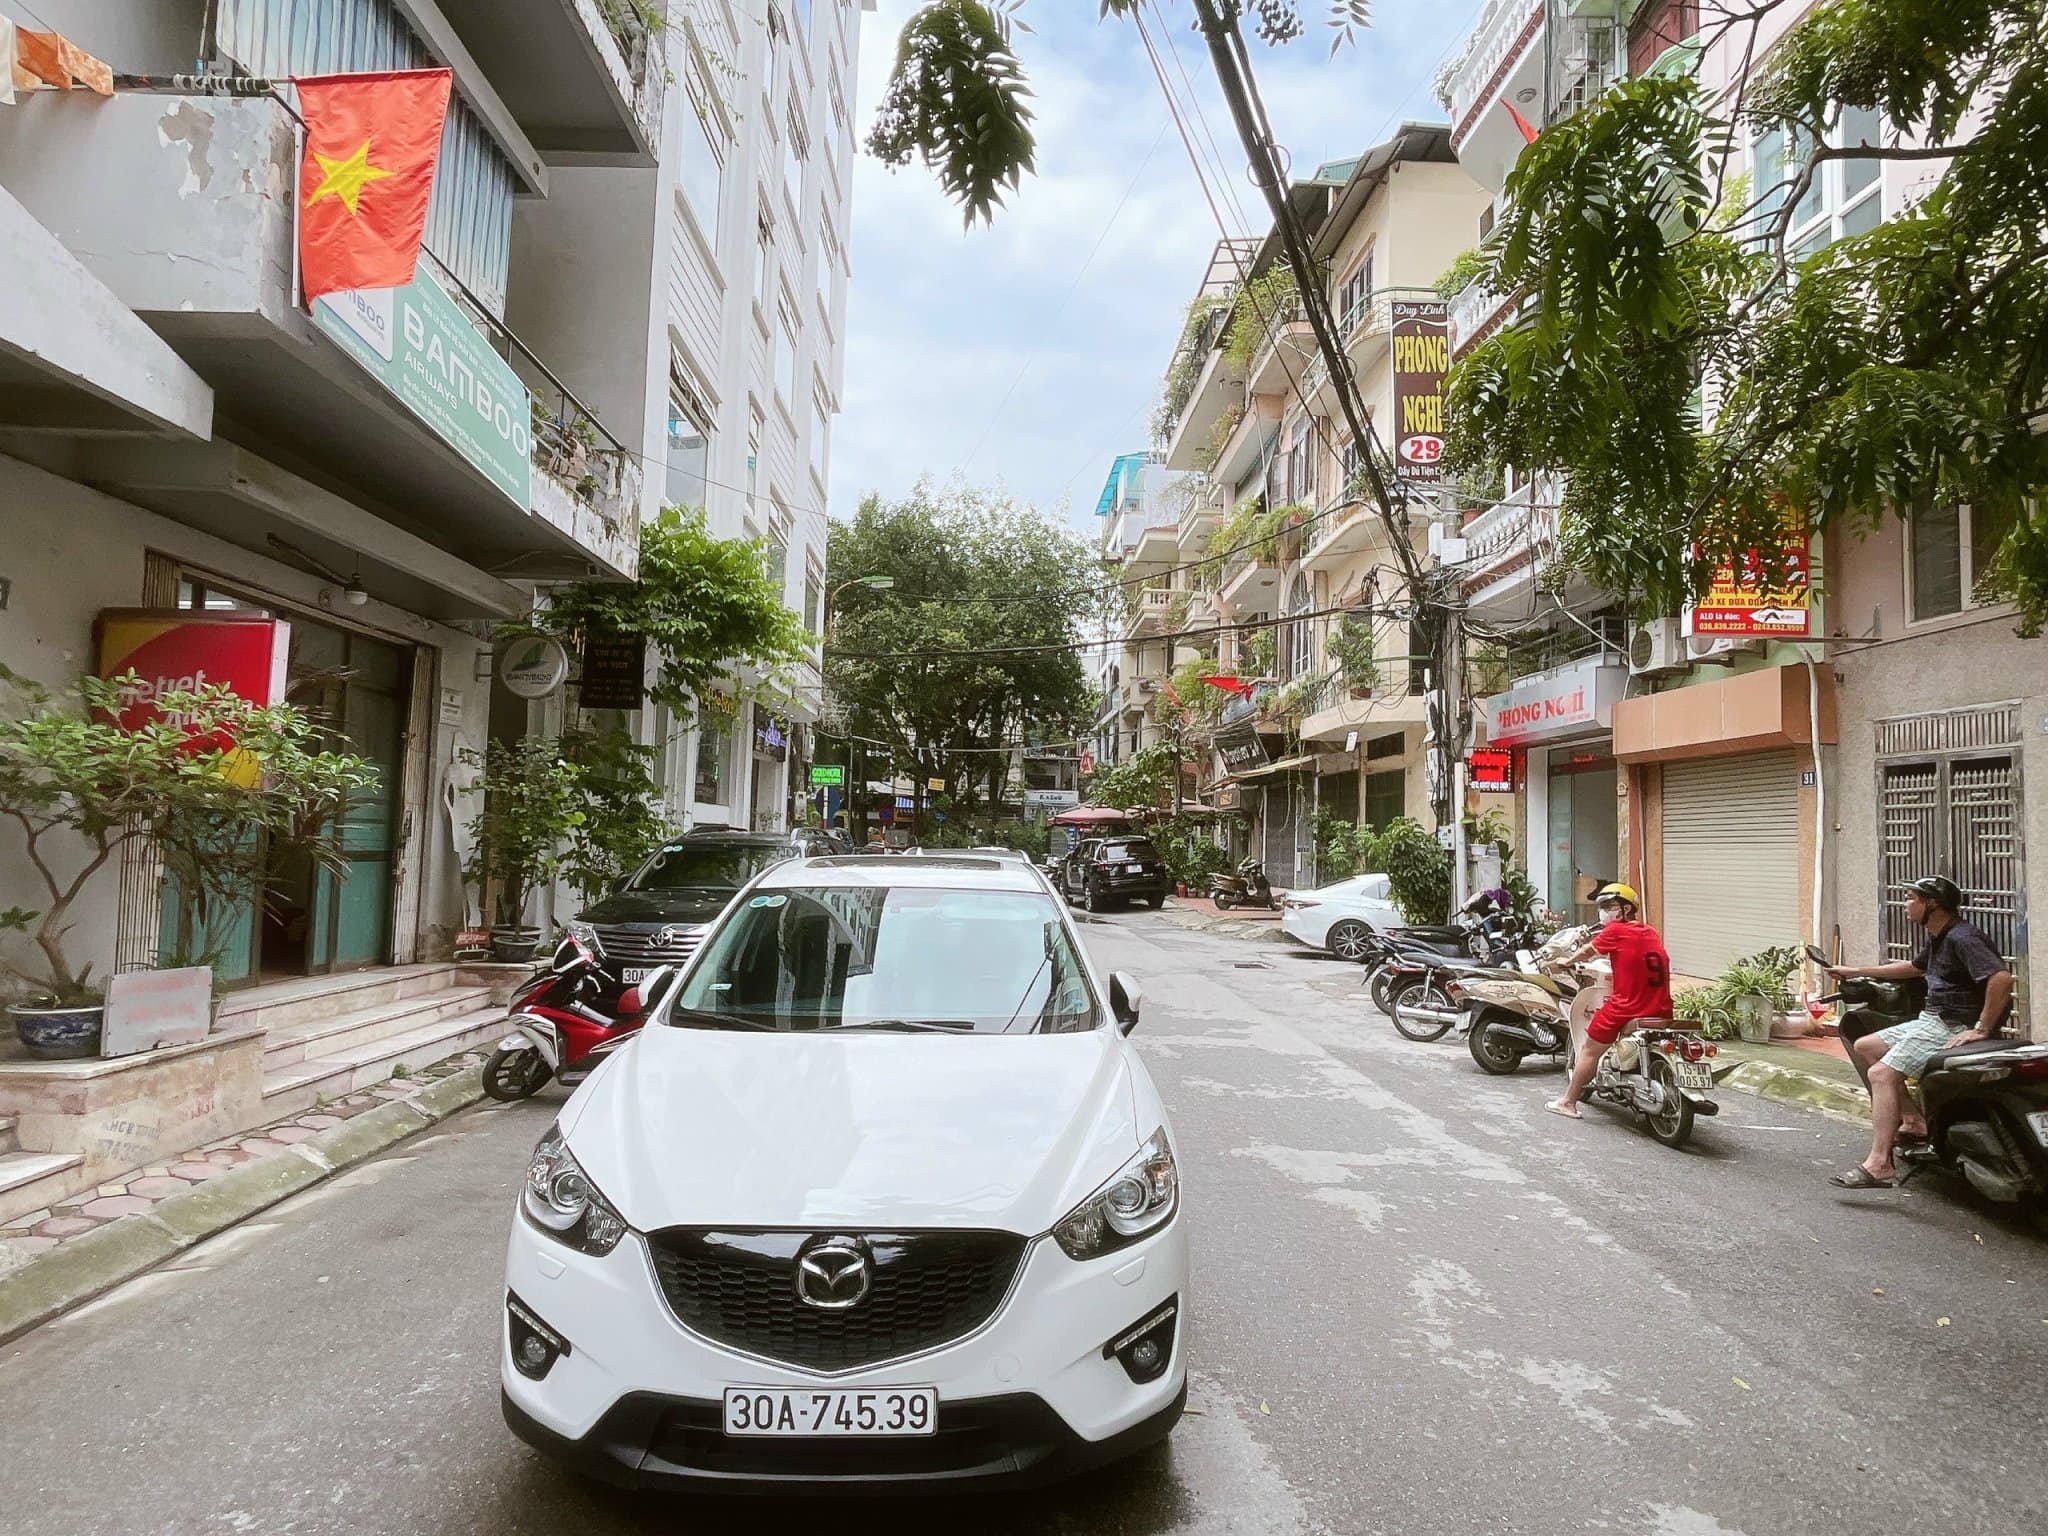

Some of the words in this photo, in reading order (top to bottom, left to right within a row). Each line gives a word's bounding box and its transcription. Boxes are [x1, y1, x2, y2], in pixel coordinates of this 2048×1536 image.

[1394, 304, 1418, 318] Duy
[1394, 325, 1448, 373] PHÒNG
[404, 302, 528, 455] BAMBOO
[405, 351, 458, 409] AIRWAYS
[1402, 380, 1443, 433] NGHỈ
[1410, 440, 1440, 459] 29
[1700, 612, 1713, 620] ALO
[1645, 951, 1665, 988] 9
[732, 1394, 928, 1431] 30A-745.39
